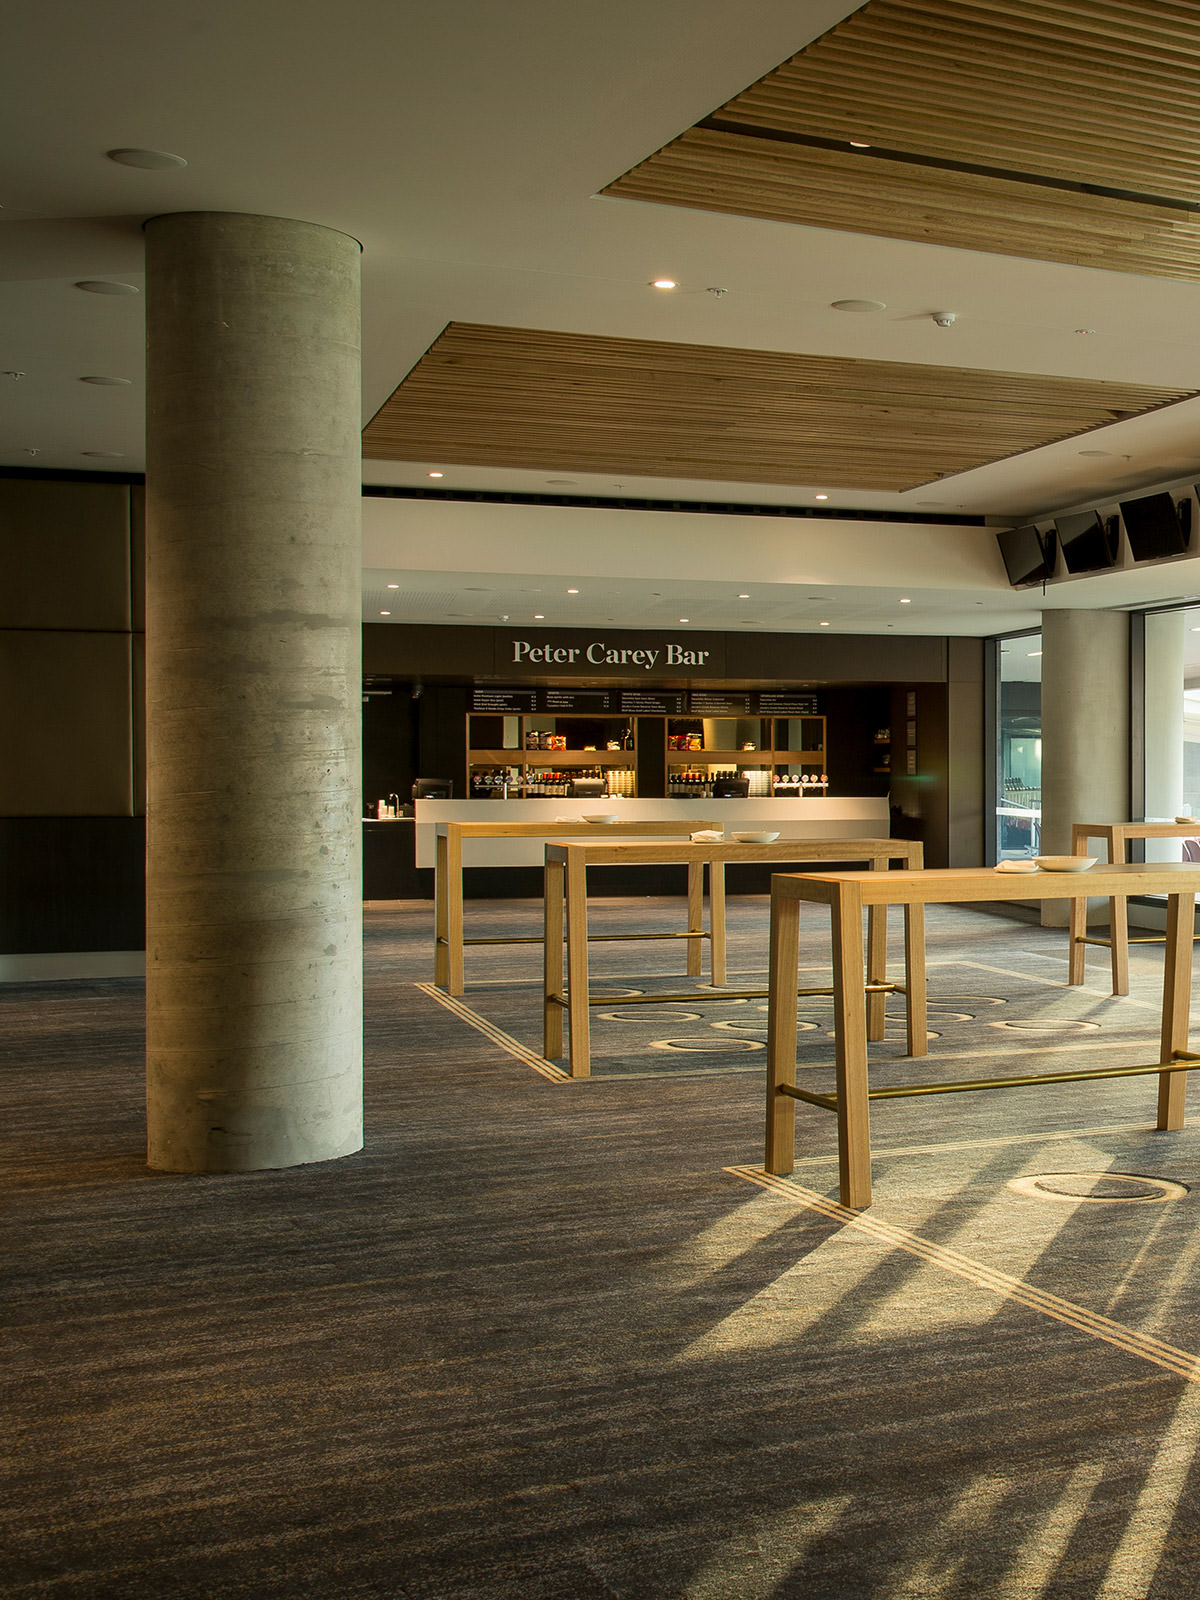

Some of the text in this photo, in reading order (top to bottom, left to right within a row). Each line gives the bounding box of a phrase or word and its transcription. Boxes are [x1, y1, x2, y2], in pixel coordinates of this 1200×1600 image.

[512, 641, 710, 670] Peter Carey Bar
